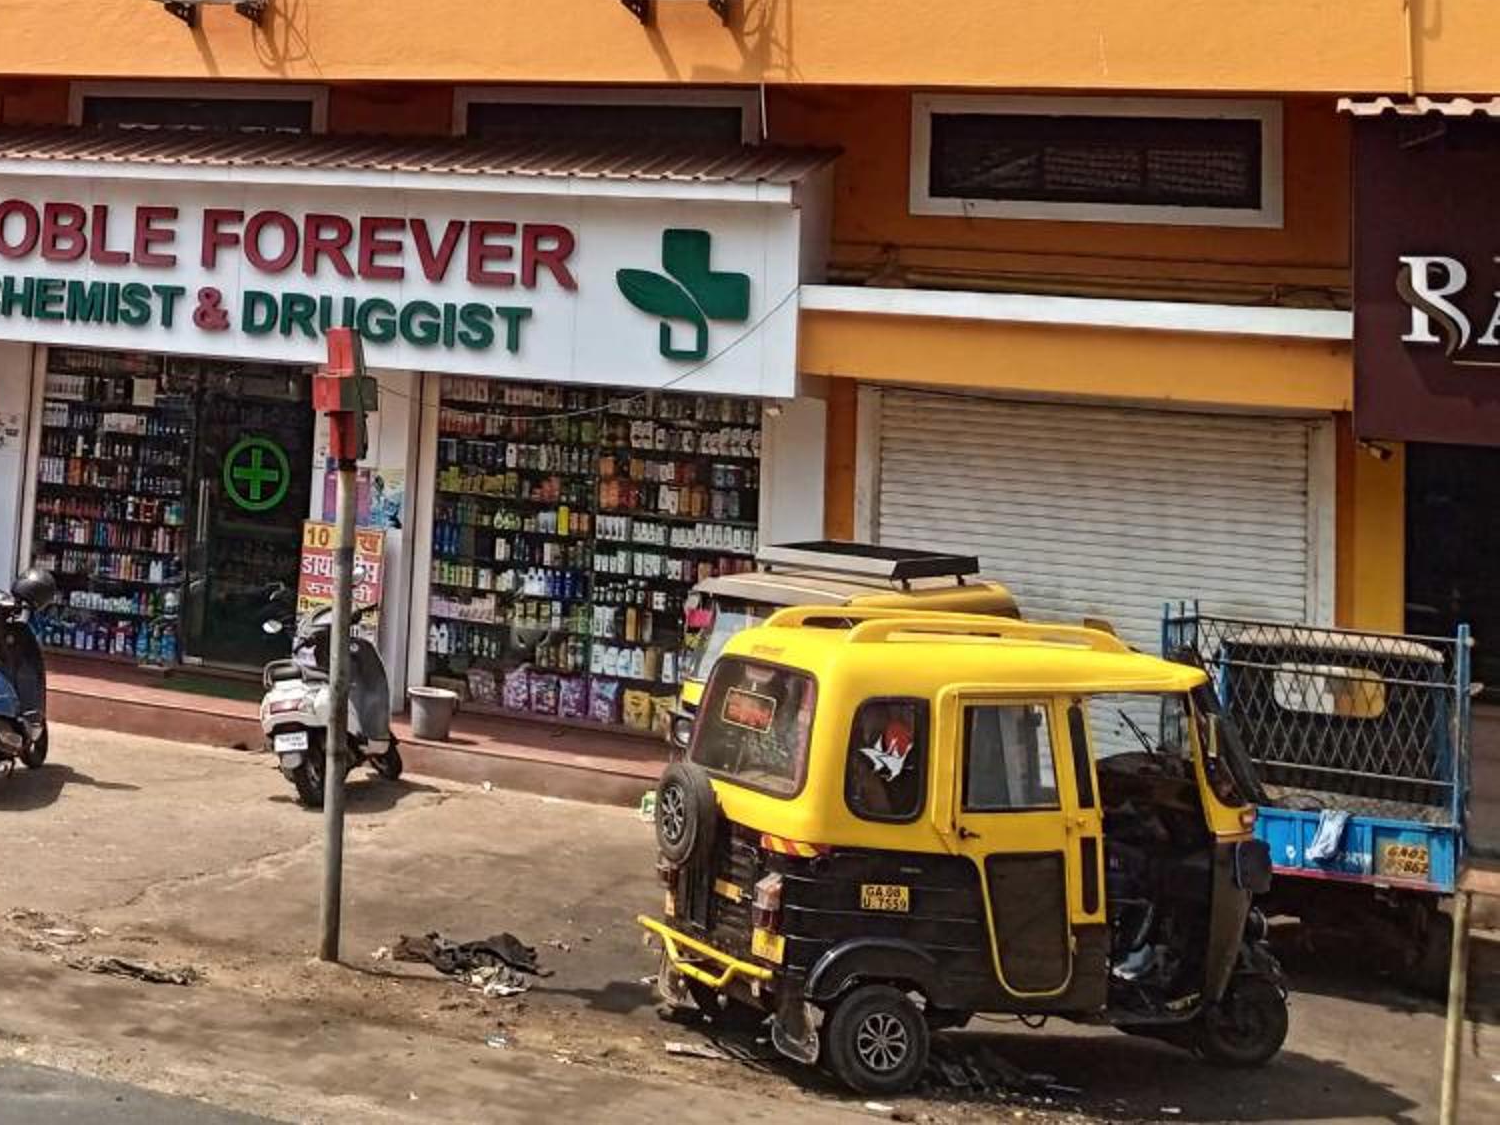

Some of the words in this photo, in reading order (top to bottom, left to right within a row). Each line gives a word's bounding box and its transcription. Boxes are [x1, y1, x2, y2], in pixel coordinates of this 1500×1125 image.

[200, 208, 580, 292] FOREVER
[193, 286, 231, 333] &
[242, 290, 533, 354] DRUGGIST
[307, 527, 329, 546] 10
